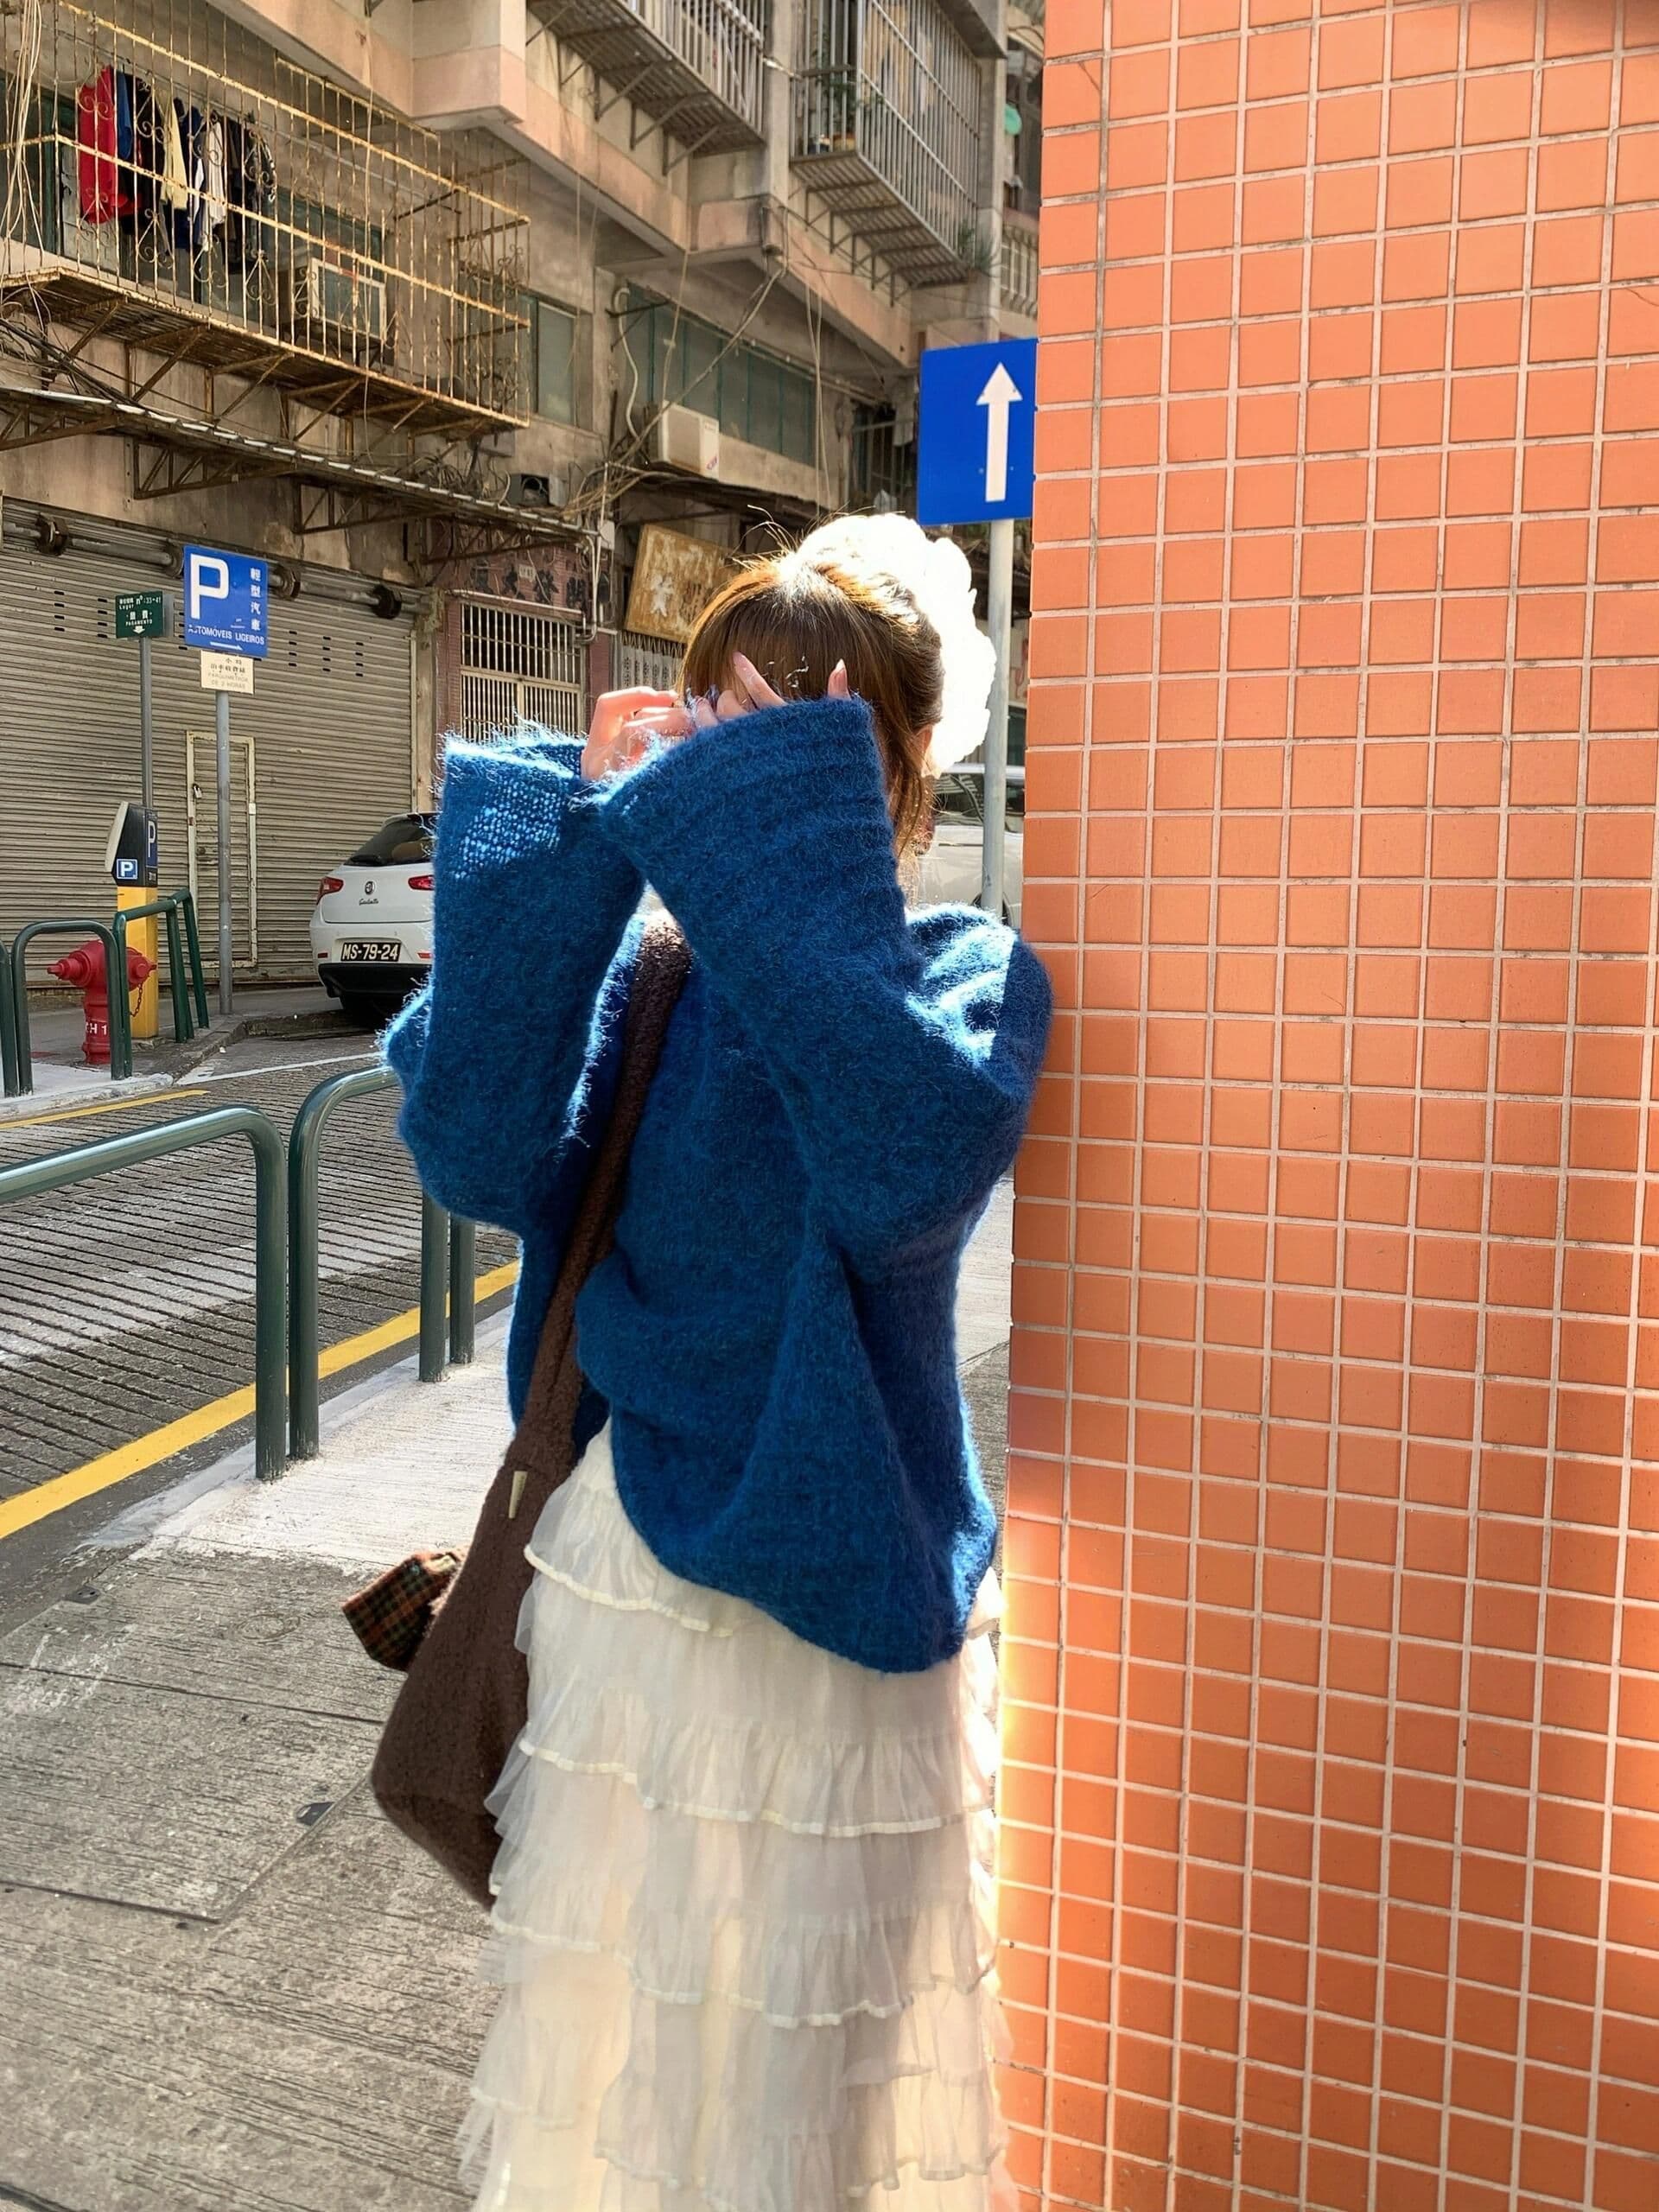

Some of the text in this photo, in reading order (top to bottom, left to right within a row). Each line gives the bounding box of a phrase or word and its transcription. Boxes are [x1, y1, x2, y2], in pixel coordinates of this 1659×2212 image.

[190, 554, 229, 620] P
[235, 632, 264, 645] LIGEIROS
[148, 820, 156, 858] P
[120, 861, 133, 877] P
[342, 944, 398, 960] MS-79-24
